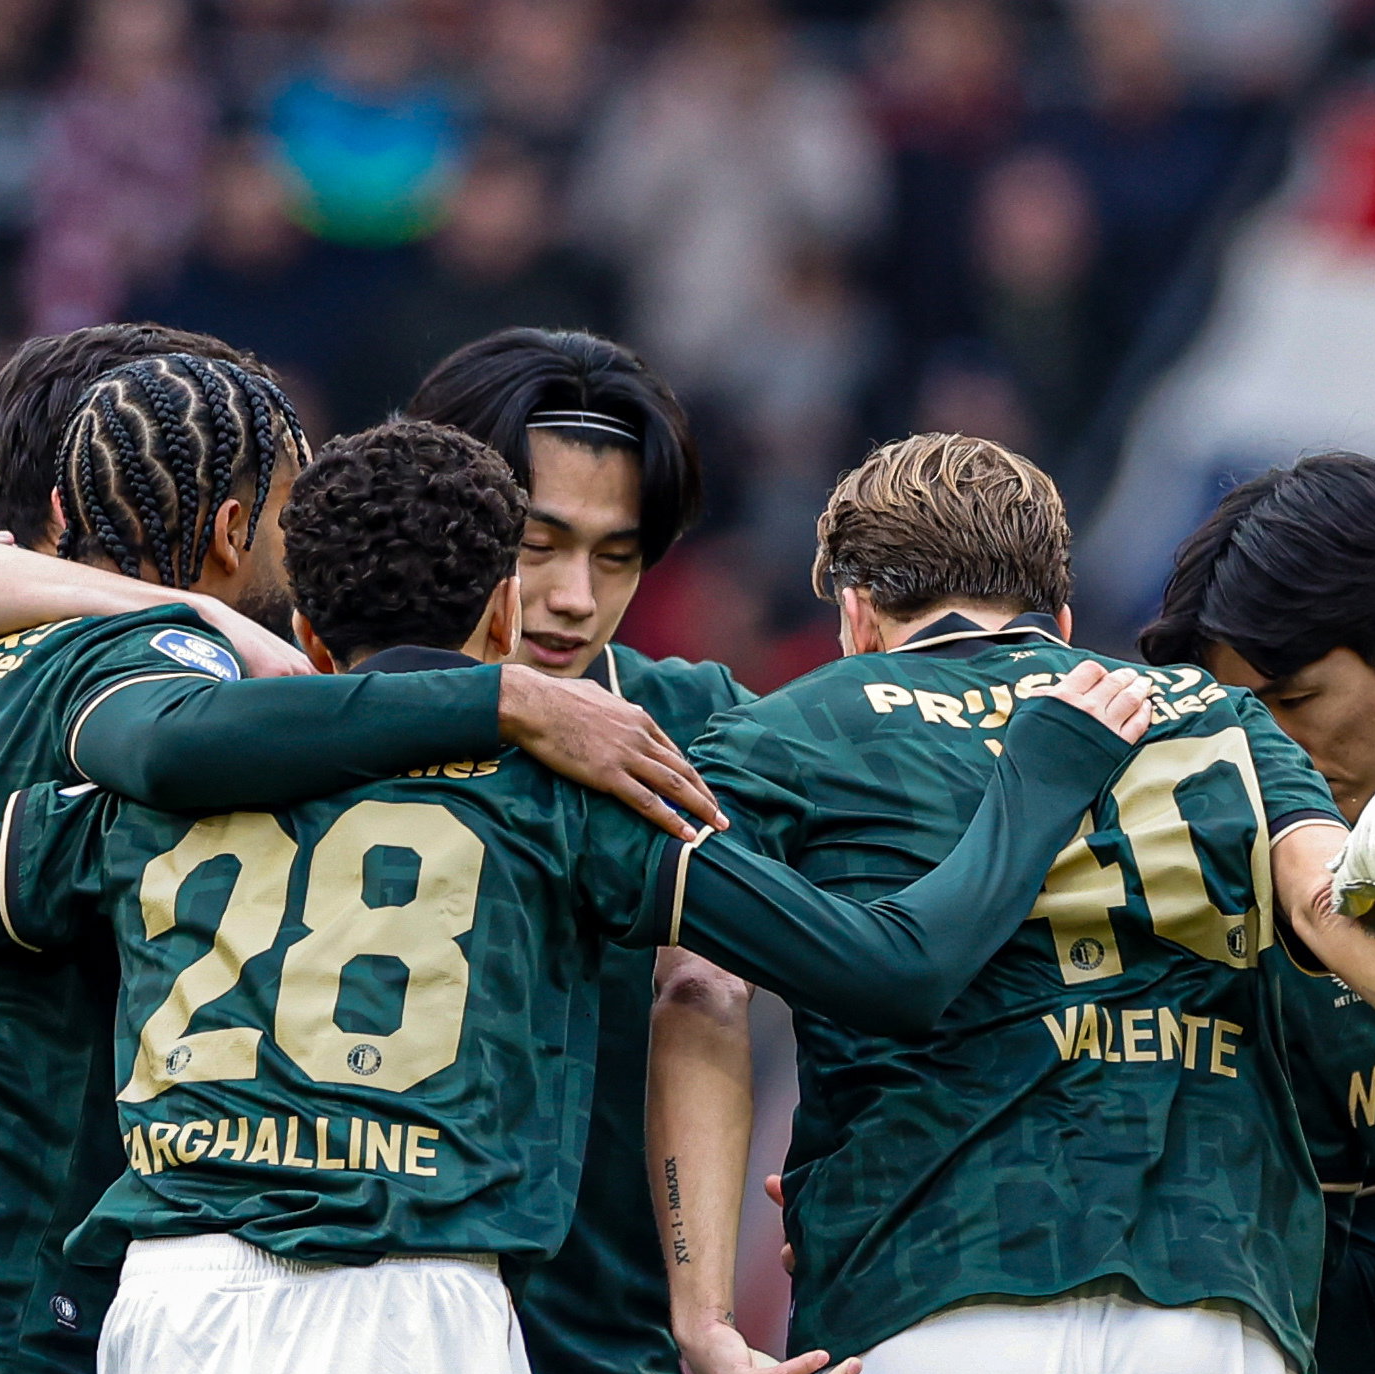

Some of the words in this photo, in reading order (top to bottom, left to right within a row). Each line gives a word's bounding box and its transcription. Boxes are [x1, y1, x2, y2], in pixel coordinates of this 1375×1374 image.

[115, 799, 486, 1104] 28
[1006, 726, 1275, 986] 40
[1041, 1002, 1244, 1079] VALENTE
